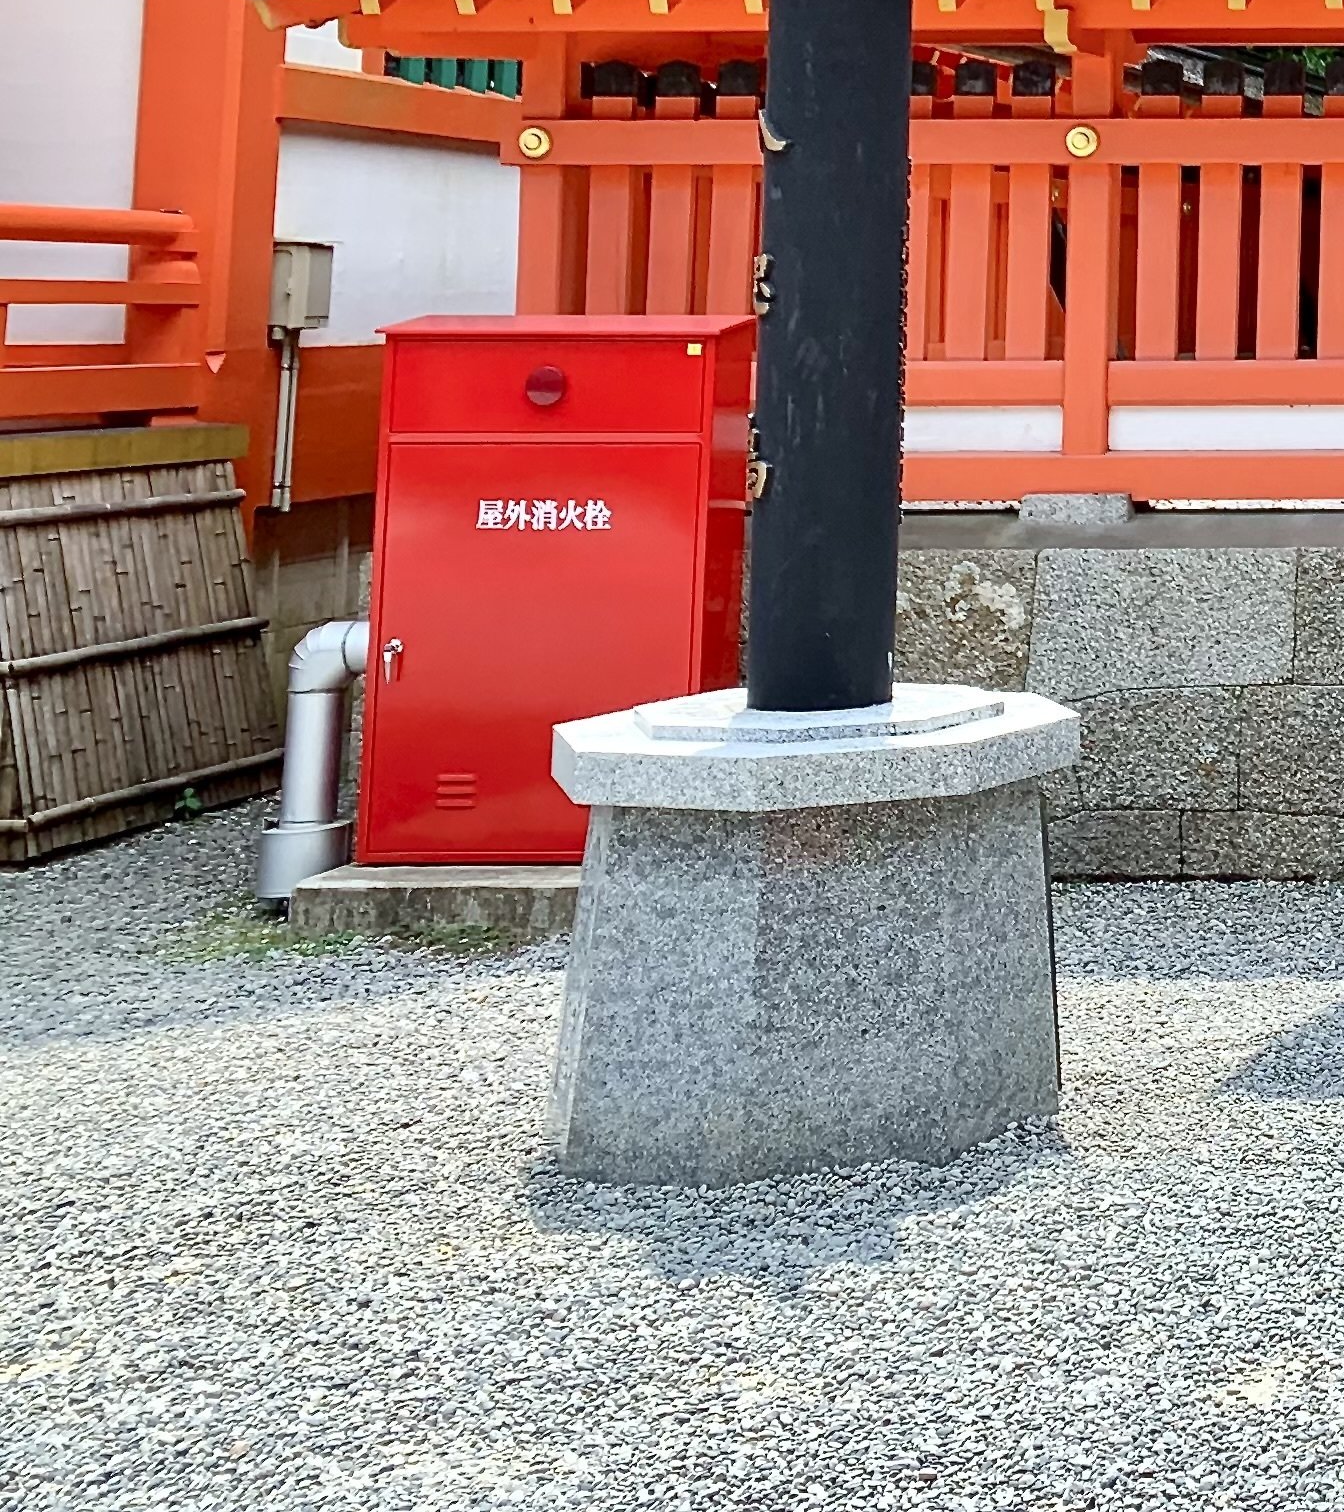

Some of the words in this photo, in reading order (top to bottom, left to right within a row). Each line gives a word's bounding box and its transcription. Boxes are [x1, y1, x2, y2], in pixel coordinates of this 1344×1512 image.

[475, 498, 612, 531] 屋外消火栓
